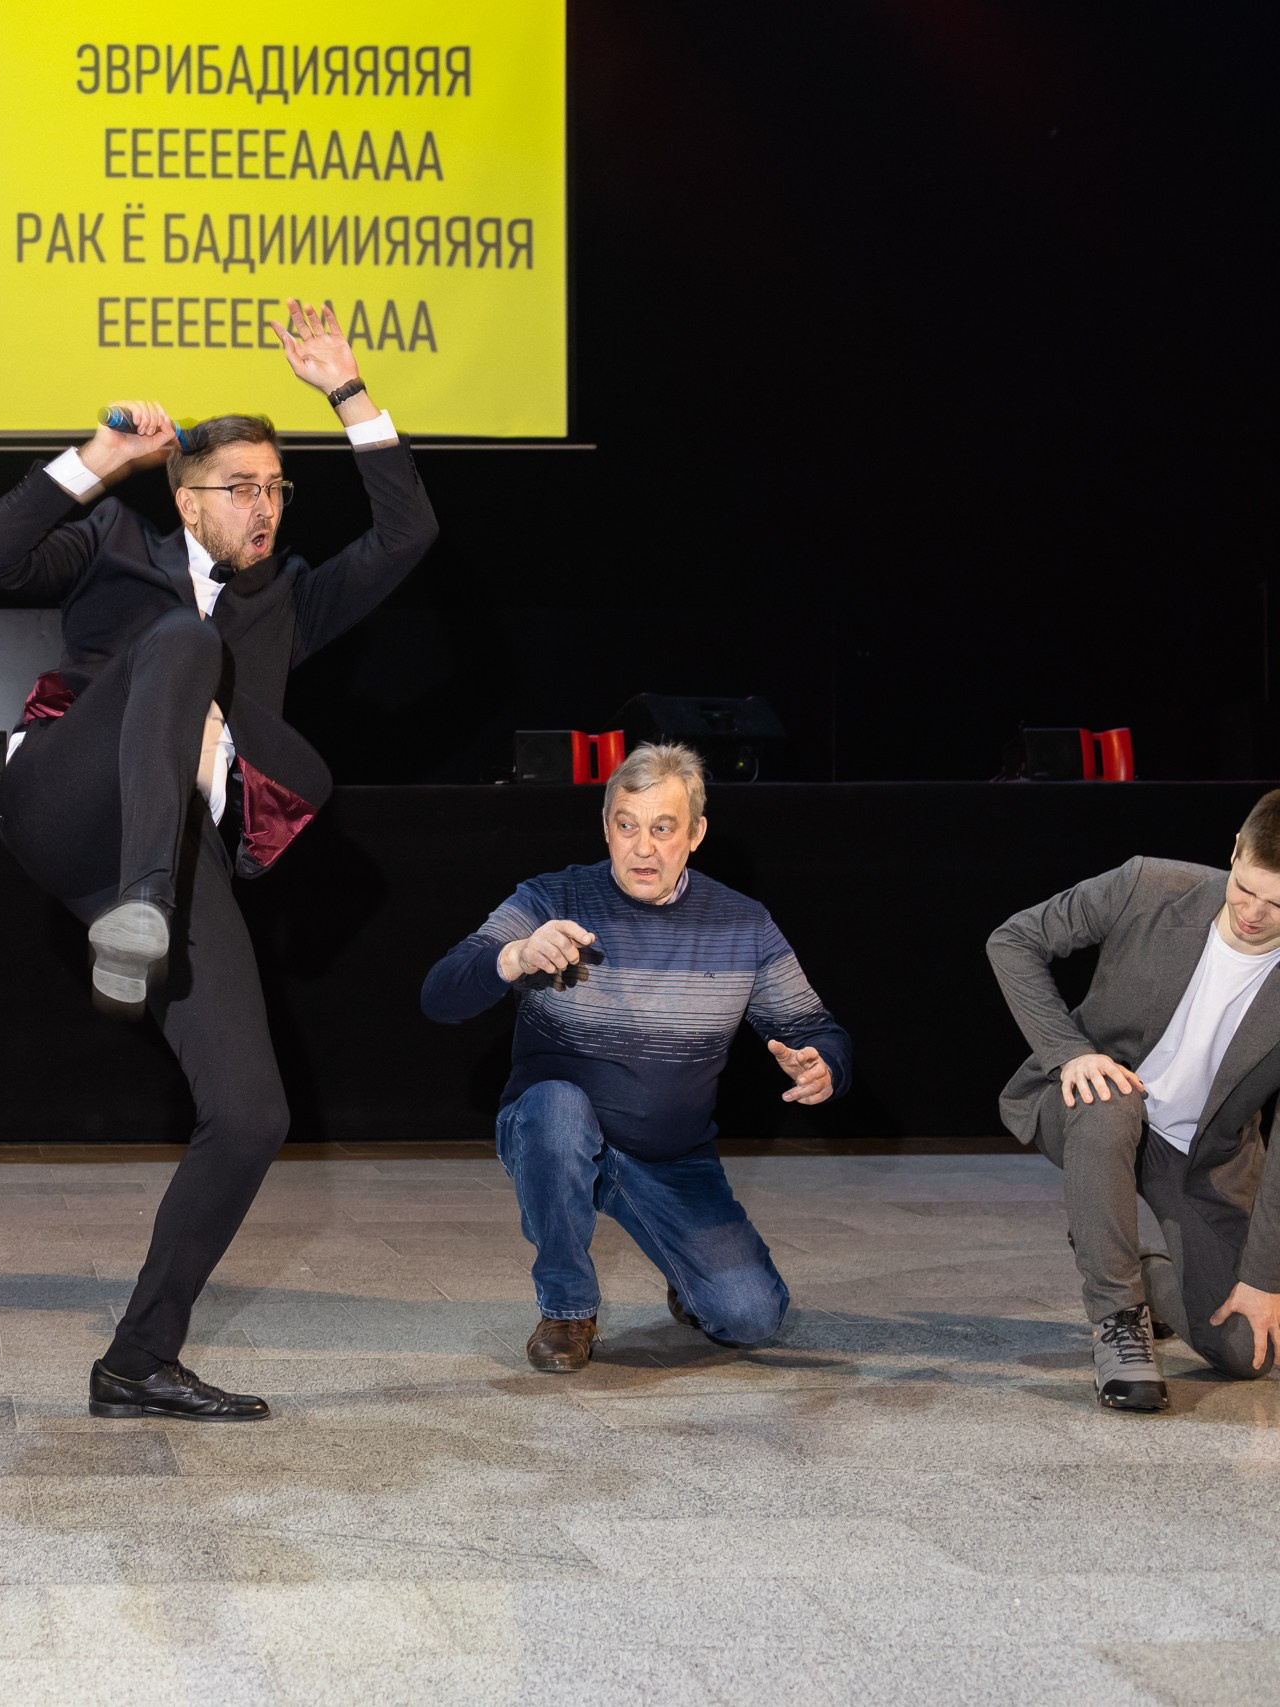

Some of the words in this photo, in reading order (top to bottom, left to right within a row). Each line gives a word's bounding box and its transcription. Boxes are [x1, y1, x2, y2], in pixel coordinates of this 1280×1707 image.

[76, 44, 471, 104] ЭВРИБАДИЯЯЯЯЯ
[105, 128, 444, 181] ЕЕЕЕЕЕЕААААА
[17, 213, 106, 263] РАК
[123, 203, 146, 263] Ё
[164, 213, 533, 274] БАДИИИИЯЯЯЯЯ
[98, 297, 438, 352] ЕЕЕЕЕЕЕААА
